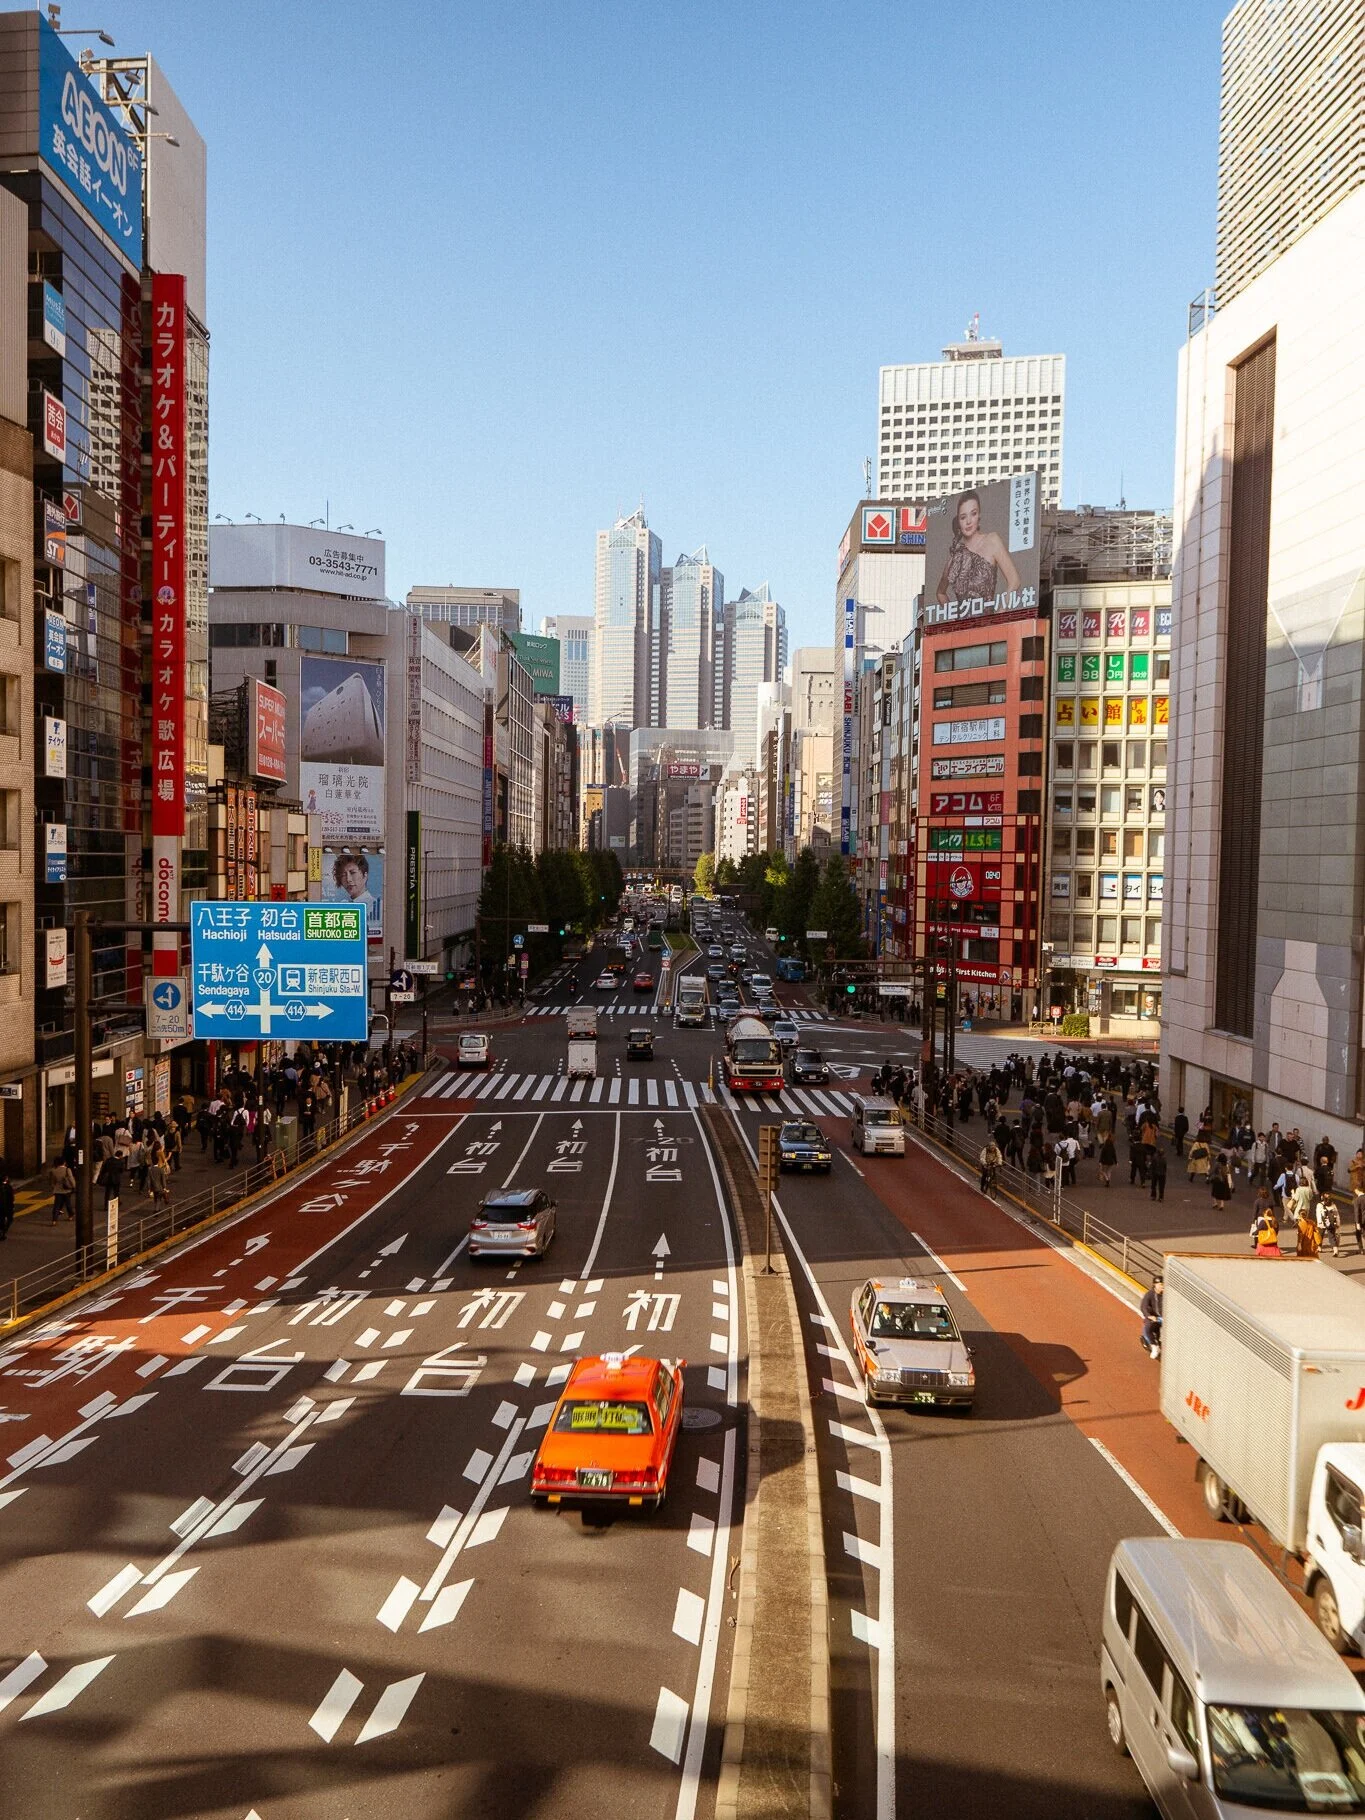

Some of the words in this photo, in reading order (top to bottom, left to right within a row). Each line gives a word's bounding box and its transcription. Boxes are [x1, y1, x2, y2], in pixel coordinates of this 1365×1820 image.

[52, 123, 133, 237] 英会話イーオン
[156, 301, 176, 581] カラオケ&パーティー
[900, 534, 926, 545] SHIN
[324, 549, 364, 563] 広告募集中
[309, 555, 378, 576] 03-3543-7771
[926, 586, 1036, 623] THEグローバル社
[1061, 655, 1121, 669] ほぐし
[533, 668, 554, 679] MIWA
[157, 614, 176, 802] カラオケ歌広場
[1057, 703, 1121, 720] 占い館
[952, 721, 986, 733] 新宿駅前
[669, 765, 698, 775] やまや
[318, 773, 369, 789] 瑠璃光院
[325, 789, 361, 800] 白蓮華堂
[990, 793, 1000, 802] 6F
[935, 794, 983, 812] アコム
[984, 817, 1001, 825] アコム
[198, 907, 252, 927] 八王子
[260, 908, 298, 928] 初台
[307, 911, 357, 928] 首都高
[203, 929, 248, 942] Hachioji
[258, 929, 301, 941] Hatsudai
[307, 928, 342, 939] SHUTOKO
[343, 929, 358, 939] EXP
[258, 971, 272, 983] 20
[308, 968, 361, 984] 新宿駅西口
[971, 969, 997, 979] Kitchen
[198, 985, 250, 997] Sendagaya
[308, 984, 338, 994] Shinjuku
[227, 1004, 244, 1016] 414
[287, 1005, 304, 1017] 414
[447, 1140, 501, 1174] 初台
[546, 1140, 589, 1173] 初台
[646, 1146, 683, 1182] 初台
[622, 1289, 681, 1332] 初
[202, 1286, 372, 1392] 初台
[400, 1288, 527, 1397] 初台
[1345, 1387, 1365, 1410] J
